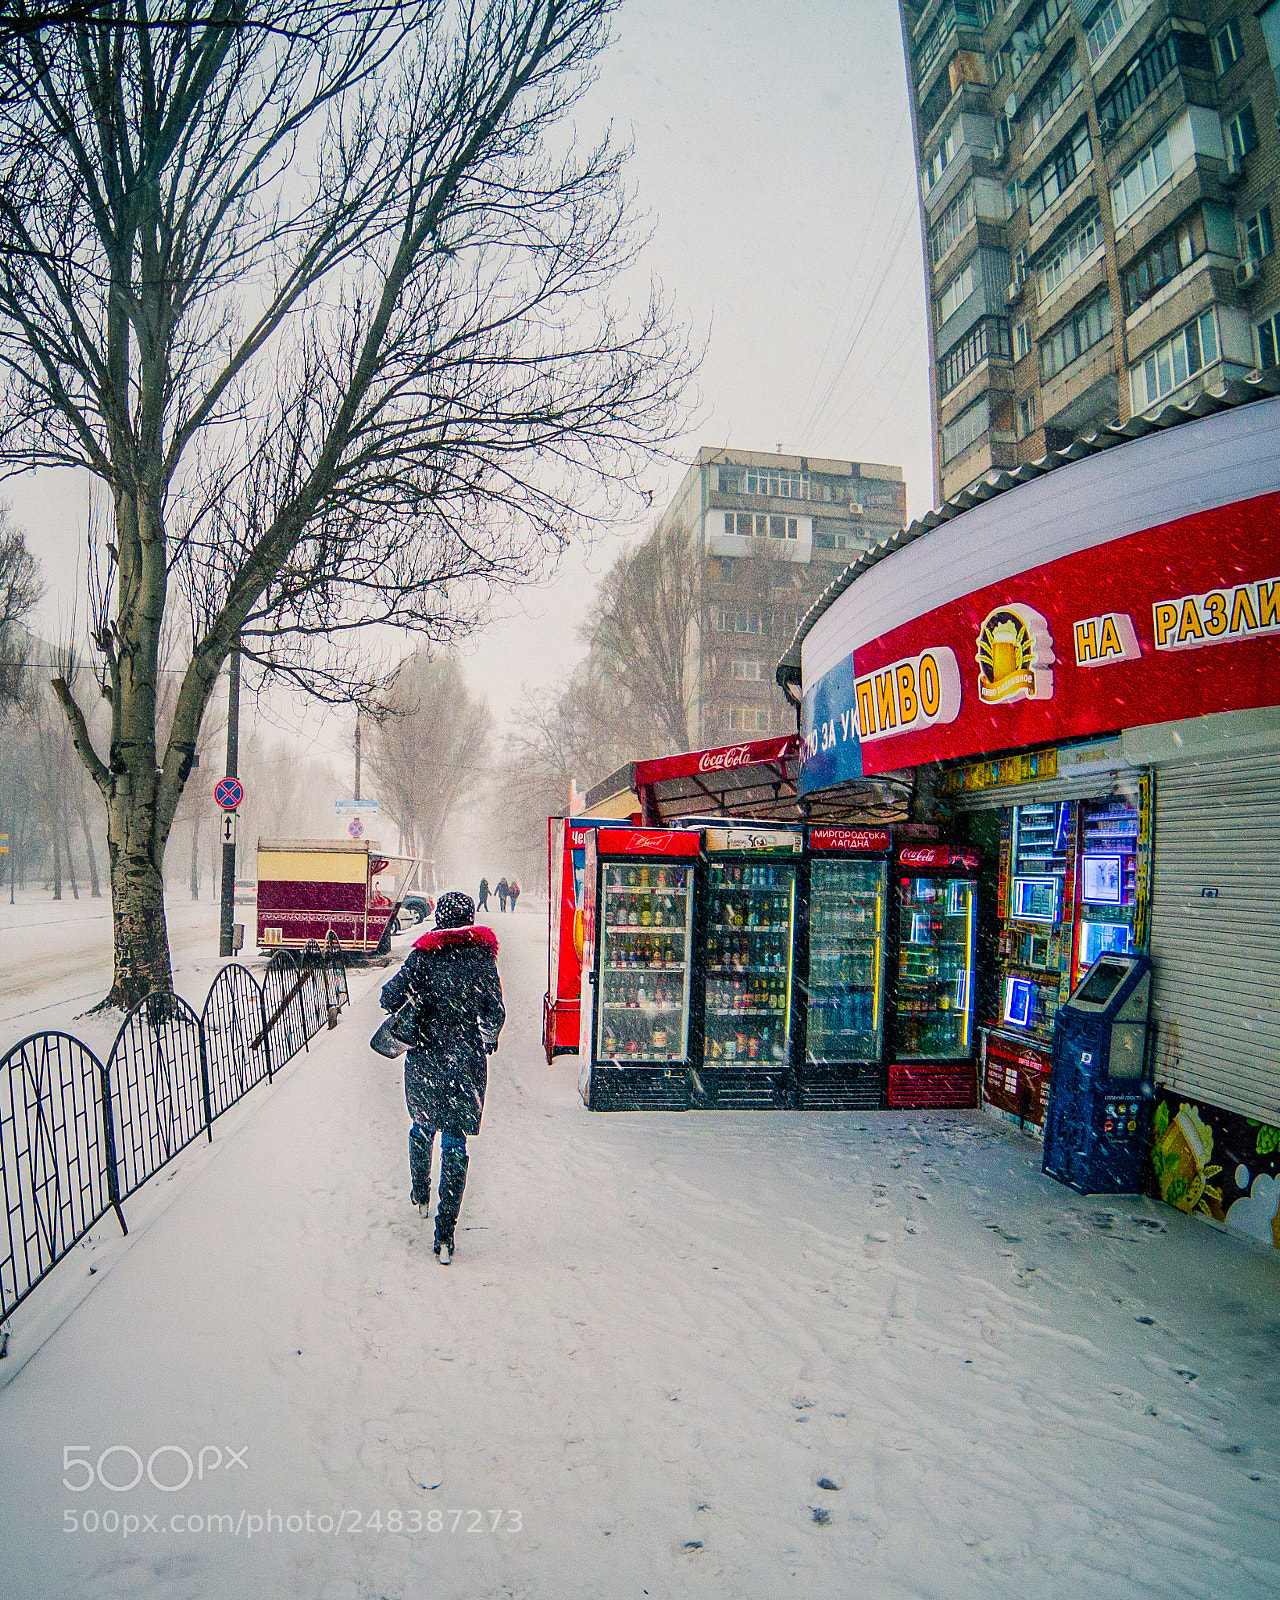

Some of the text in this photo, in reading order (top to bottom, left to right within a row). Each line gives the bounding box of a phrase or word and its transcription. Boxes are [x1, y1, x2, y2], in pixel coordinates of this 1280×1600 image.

[856, 654, 941, 737] ПИВО
[1075, 617, 1123, 662] НА
[821, 719, 836, 751] ЗА
[699, 744, 752, 772] Coca-Cola
[572, 831, 586, 844] Че
[635, 836, 663, 847] Bud
[814, 829, 887, 840] МИРГОРОДСЬКА
